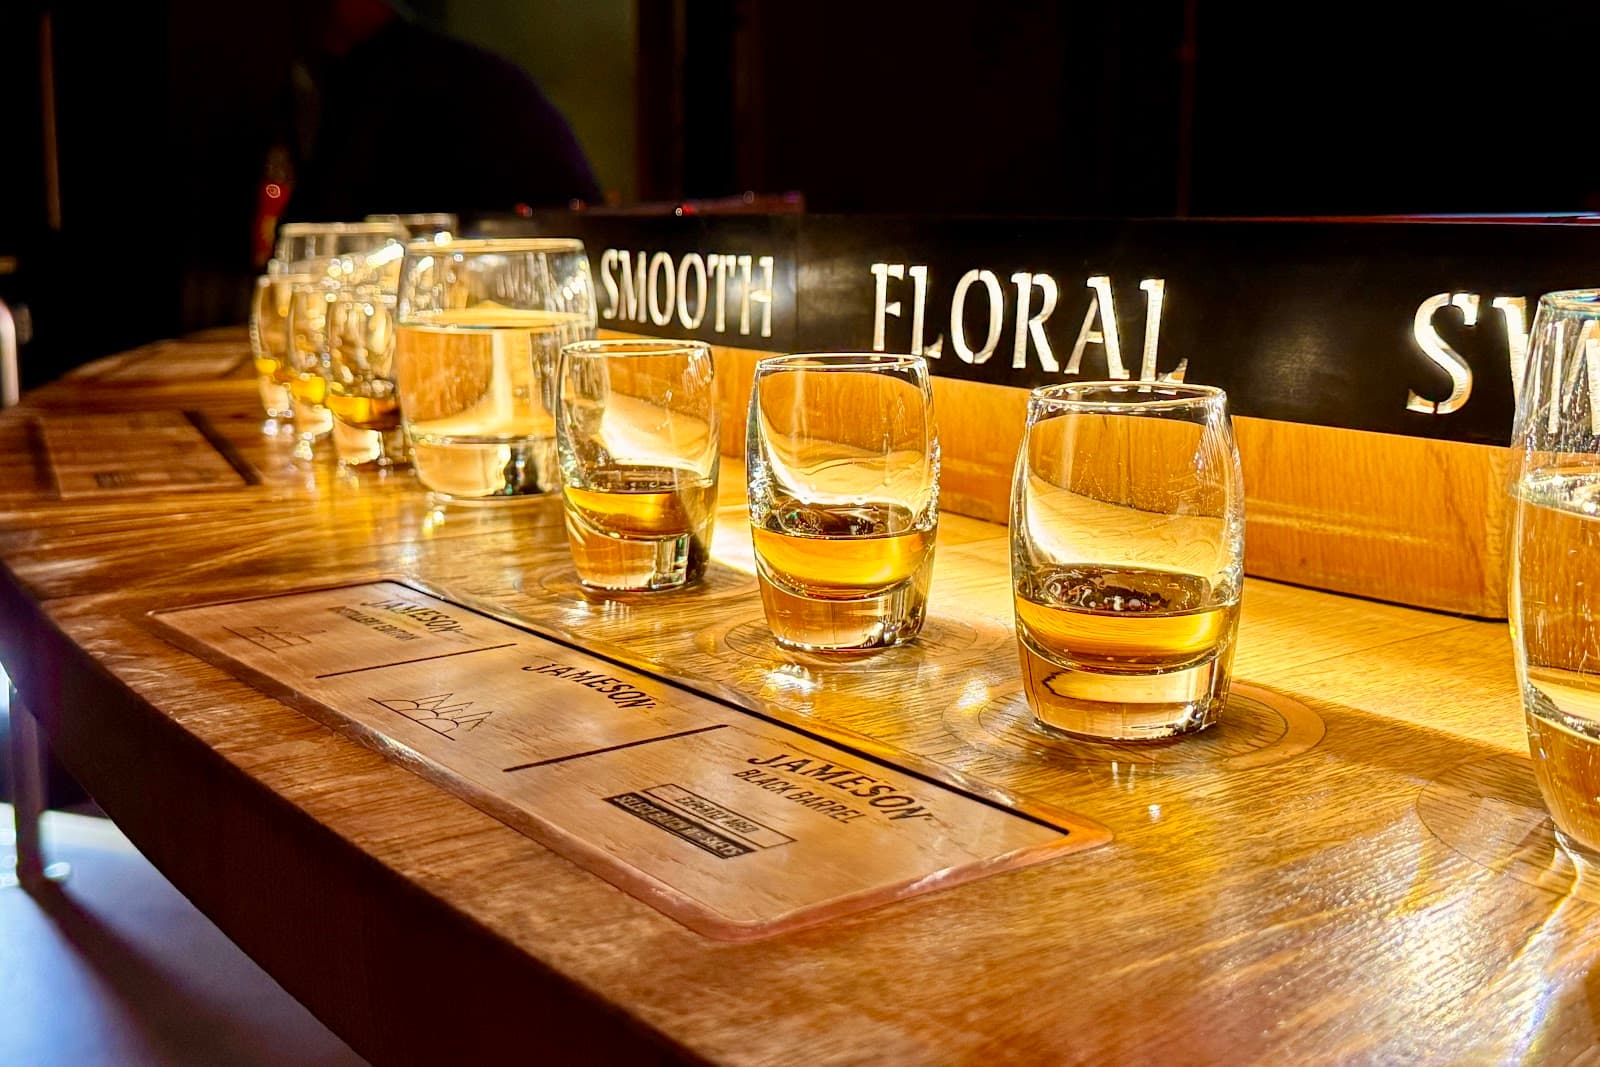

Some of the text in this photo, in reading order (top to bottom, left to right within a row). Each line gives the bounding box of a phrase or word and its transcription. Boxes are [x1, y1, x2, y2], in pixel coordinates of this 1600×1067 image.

[600, 248, 774, 337] SMOOTH
[871, 263, 1188, 388] FLORAL
[360, 600, 463, 633] JAMESON
[521, 663, 656, 709] JAMESON
[676, 797, 734, 821] EXPERTLY
[733, 768, 869, 824] BLACK BARREL
[747, 754, 929, 823] JAMESON
